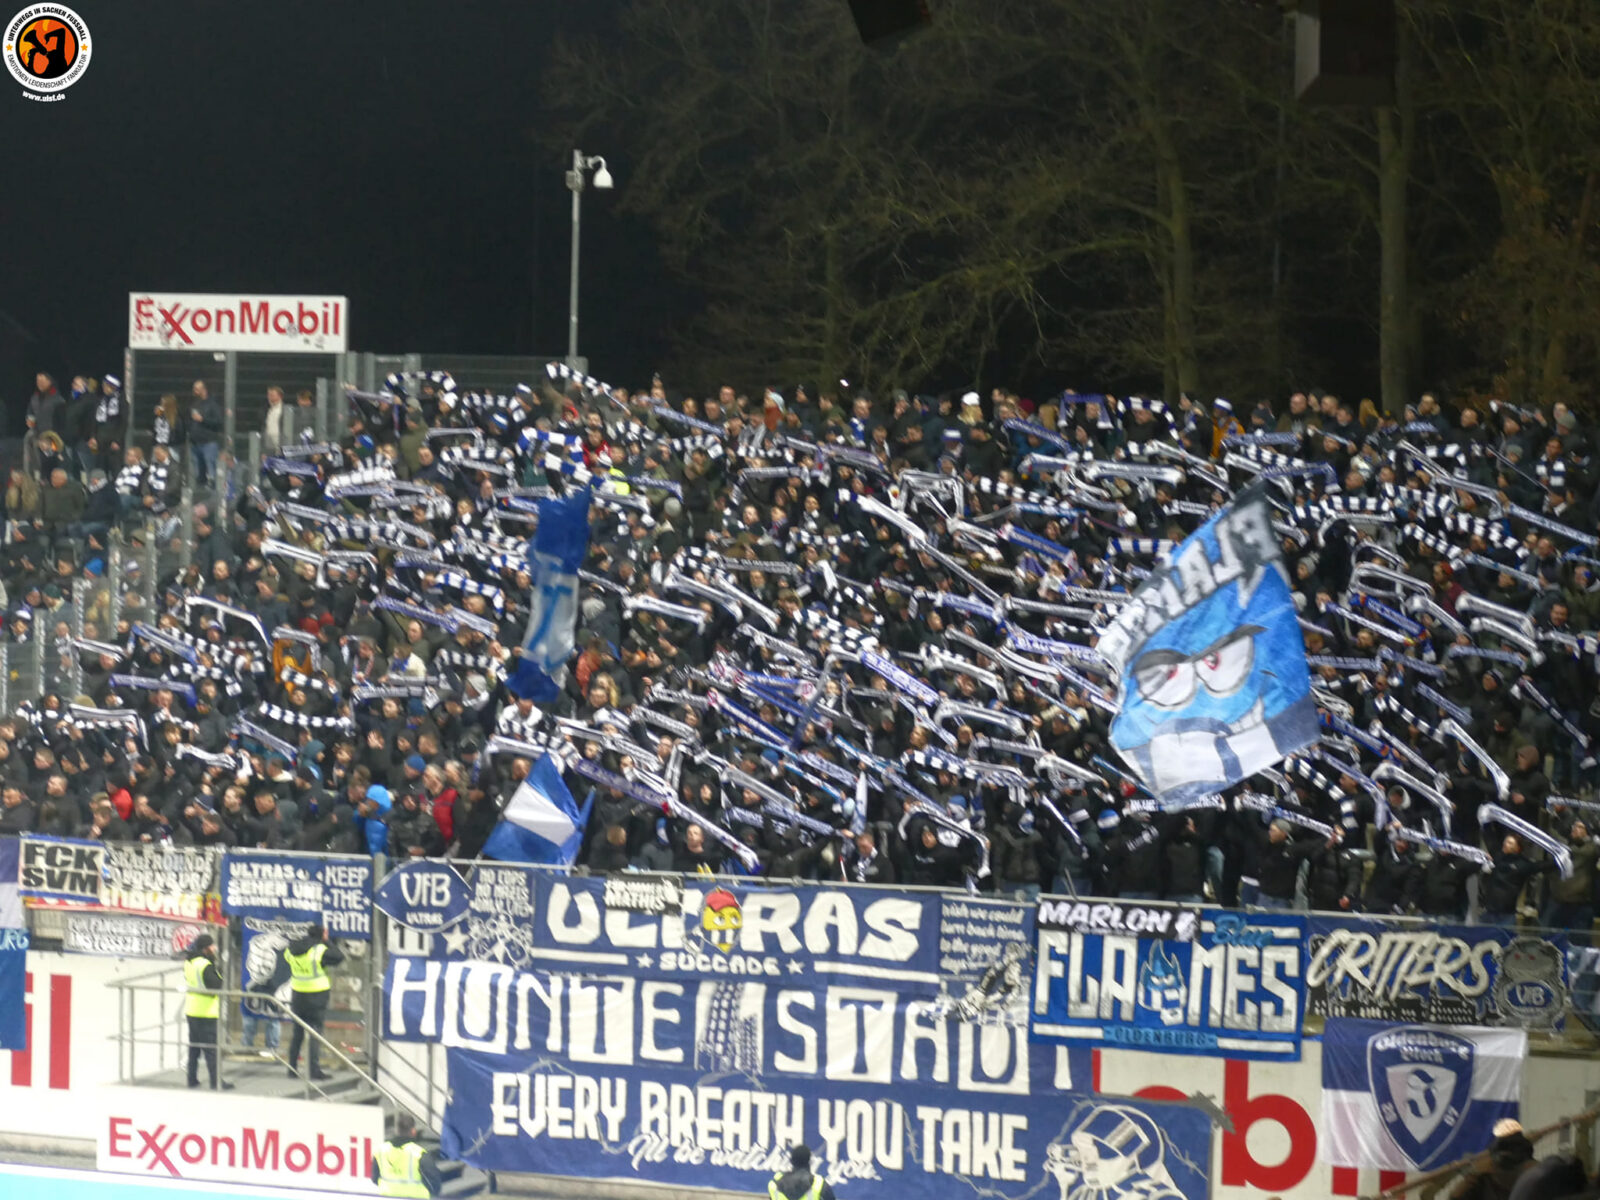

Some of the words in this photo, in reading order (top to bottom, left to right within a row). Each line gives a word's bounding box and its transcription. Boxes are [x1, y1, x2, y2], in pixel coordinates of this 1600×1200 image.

[134, 299, 340, 345] ExxonMobil
[24, 843, 99, 871] FCK
[229, 862, 295, 880] ULTRAS
[22, 868, 98, 895] SVM
[325, 866, 370, 888] KEEP
[400, 872, 451, 908] VfB
[330, 888, 363, 910] THE
[322, 910, 370, 933] FAITH
[1038, 901, 1172, 934] MARLON
[659, 952, 781, 976] SUCCADE
[1034, 929, 1300, 1033] FLAMES
[1306, 928, 1503, 1001] CRITTERS
[390, 957, 684, 1066] HUNTE
[491, 1072, 627, 1141] EVERY
[640, 1080, 804, 1151] BREATH
[818, 1097, 904, 1170] YOU
[917, 1105, 1027, 1182] TAKE
[109, 1116, 373, 1179] ExxonMobil
[674, 1138, 706, 1165] be
[825, 1160, 882, 1186] you
